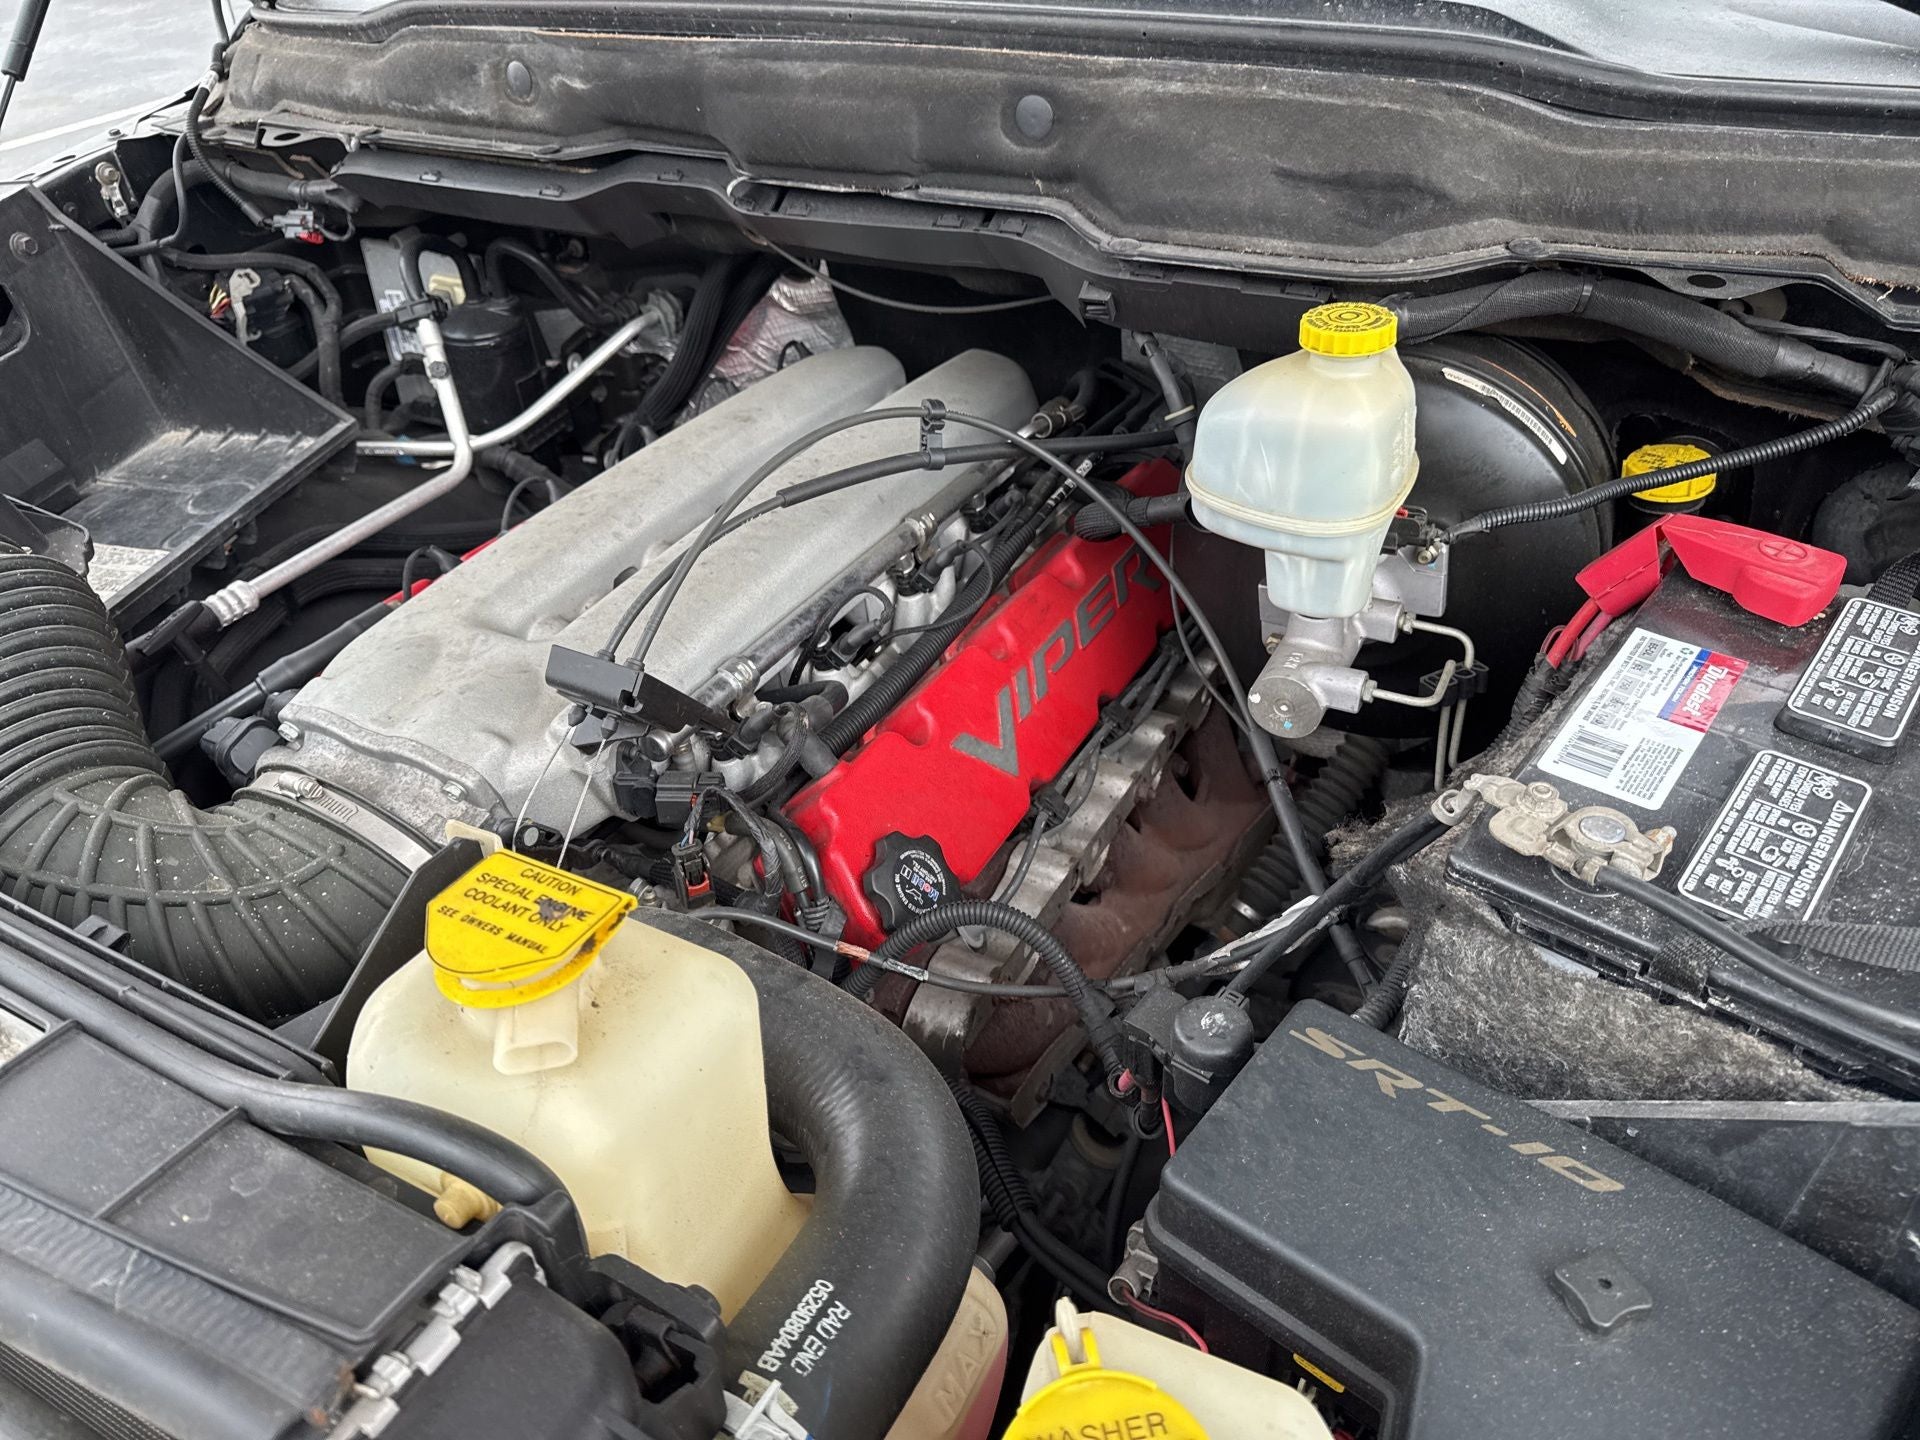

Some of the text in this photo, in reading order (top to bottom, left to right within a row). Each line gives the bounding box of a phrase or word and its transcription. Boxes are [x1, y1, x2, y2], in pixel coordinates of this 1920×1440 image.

[951, 538, 1162, 778] VIPER
[1680, 664, 1728, 717] Duralast
[475, 872, 595, 922] SPECIAL ENGINE
[520, 868, 582, 896] CAUTION
[910, 872, 939, 901] Mobil
[437, 905, 549, 954] SEE OWNERS MANUAL
[463, 887, 570, 933] COOLANT ONLY
[1289, 1027, 1625, 1192] SRT-10
[757, 1279, 834, 1372] 05290804AB
[815, 1300, 852, 1340] RAD
[1025, 1411, 1168, 1440] SHER
